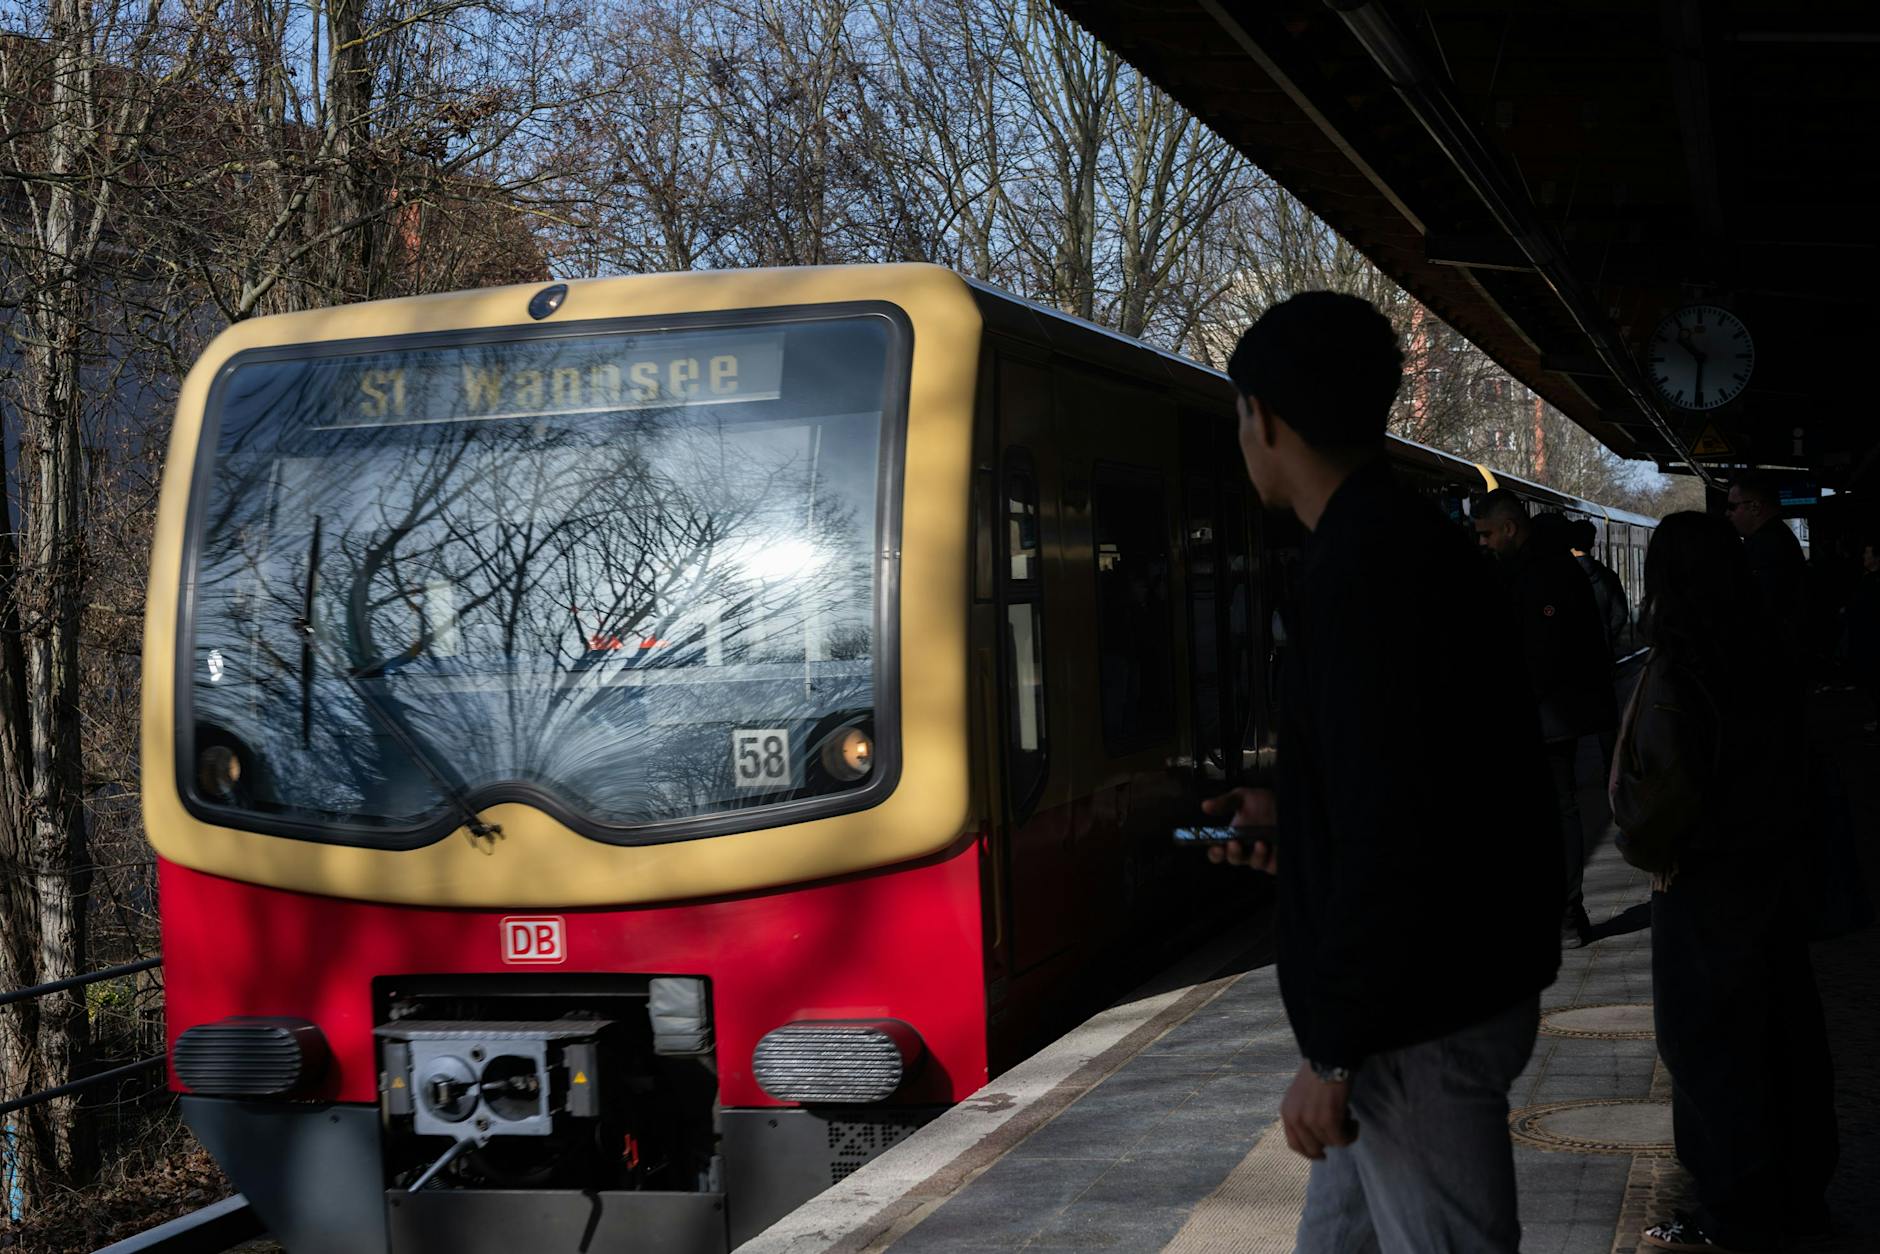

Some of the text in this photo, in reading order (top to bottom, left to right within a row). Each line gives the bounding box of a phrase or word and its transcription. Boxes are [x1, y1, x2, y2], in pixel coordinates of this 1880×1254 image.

[462, 355, 739, 412] Wannsee
[739, 735, 785, 779] 58
[511, 924, 556, 956] DB
